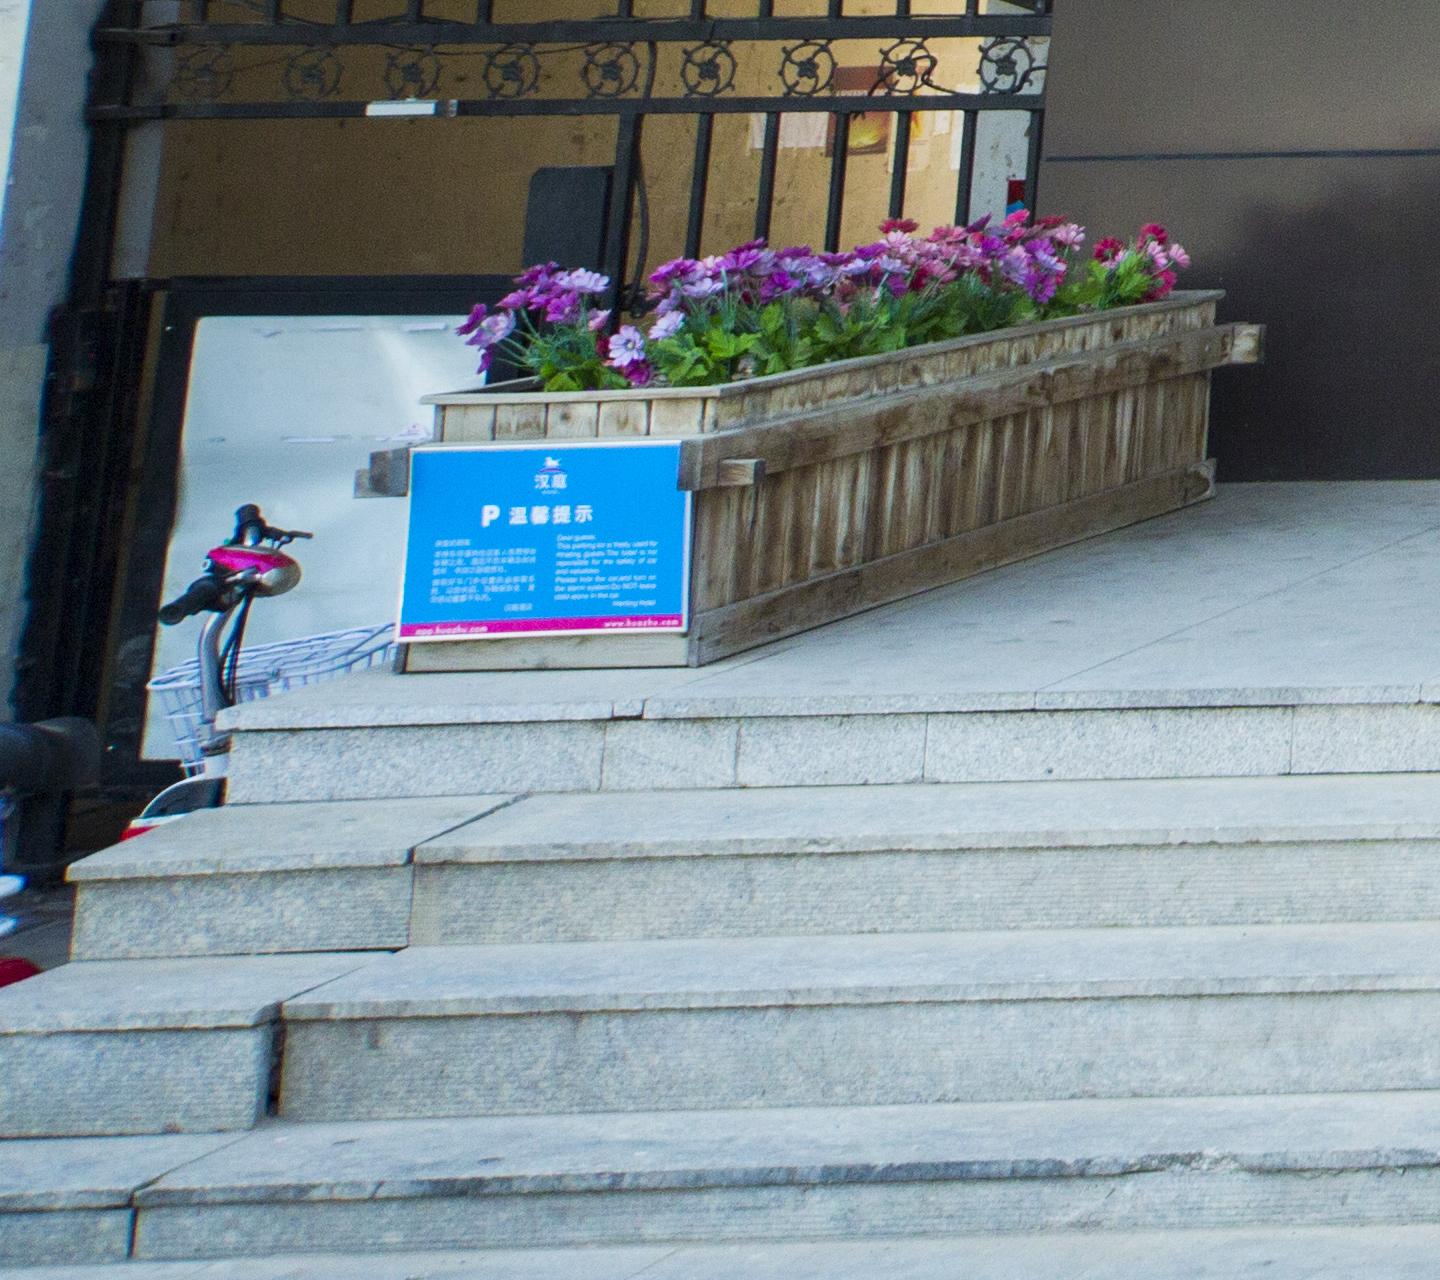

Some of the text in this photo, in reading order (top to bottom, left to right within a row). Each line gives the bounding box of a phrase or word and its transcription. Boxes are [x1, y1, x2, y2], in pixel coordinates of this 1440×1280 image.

[534, 472, 568, 491] 汉庭
[481, 504, 594, 528] P 温馨提示
